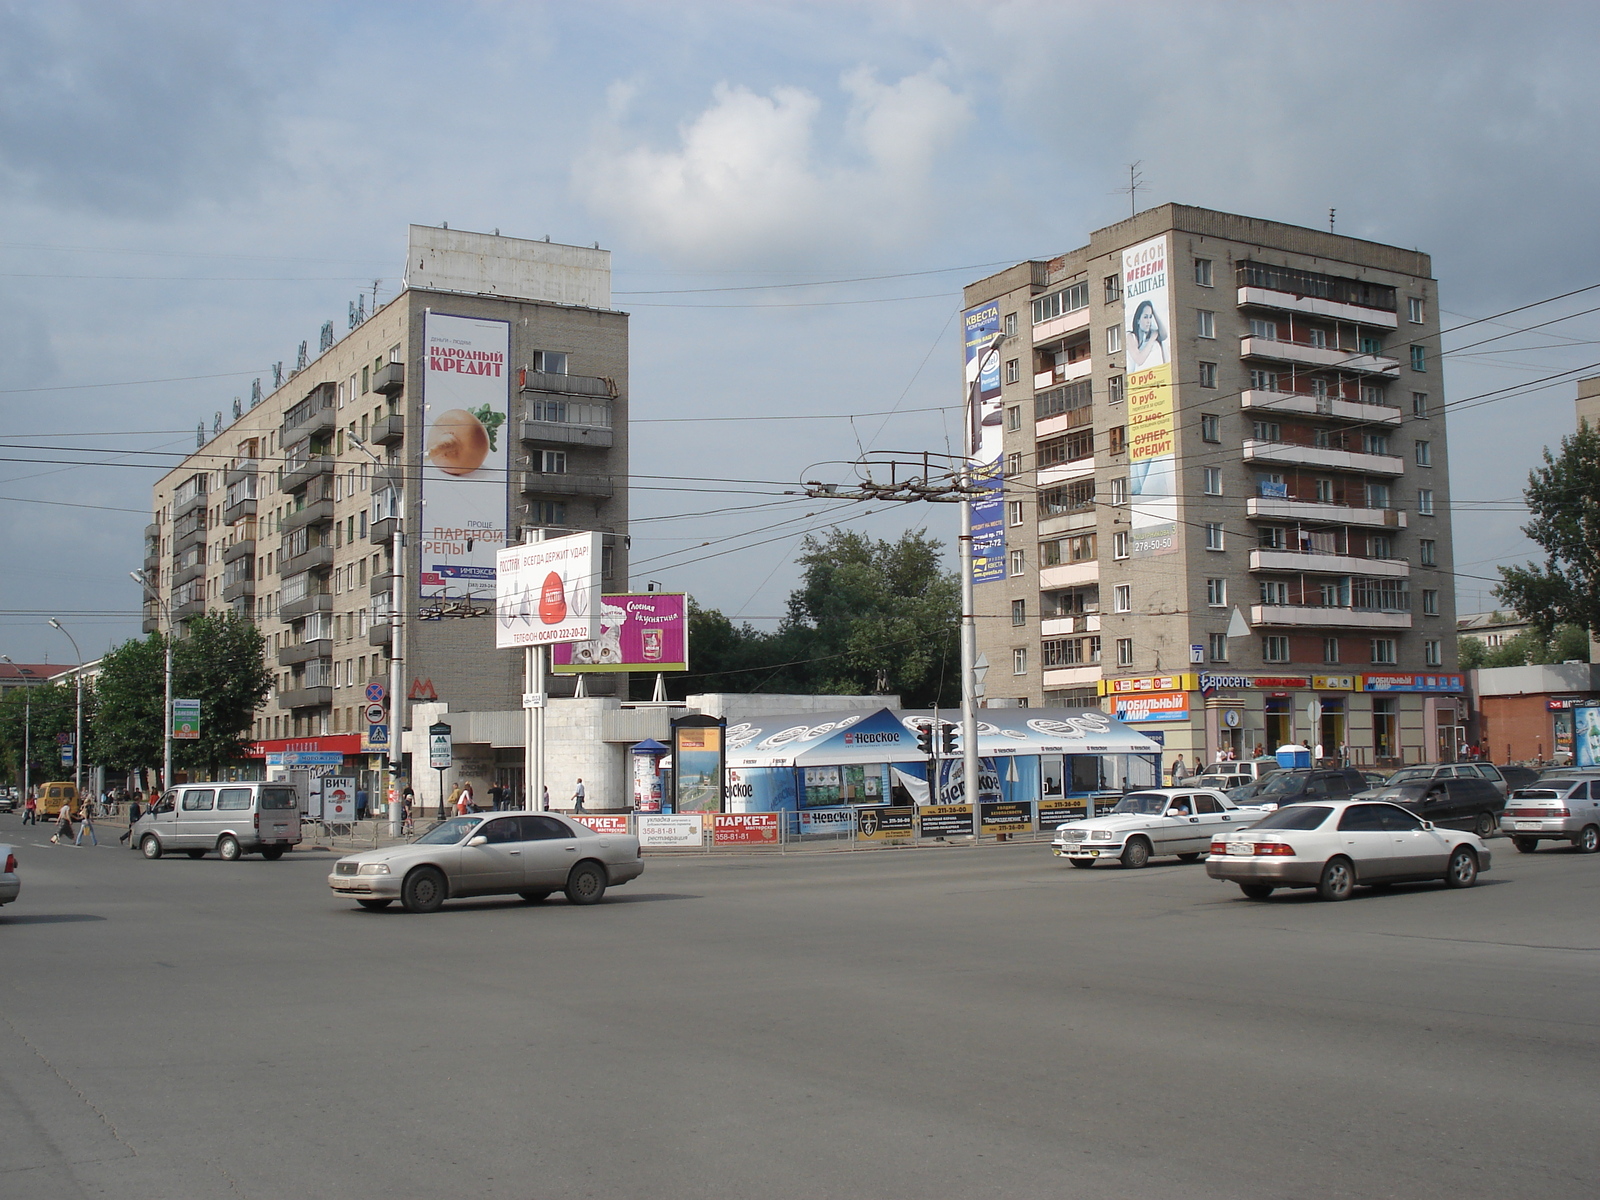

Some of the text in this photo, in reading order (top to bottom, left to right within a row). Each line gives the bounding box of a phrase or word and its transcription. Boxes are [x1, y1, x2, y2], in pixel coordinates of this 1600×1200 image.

[1126, 243, 1164, 268] САЛОН
[1127, 258, 1164, 282] МЕБЕЛИ
[1127, 273, 1165, 299] КАШТАН
[966, 306, 998, 326] КВЕСТА
[430, 346, 503, 362] НАРОДНЫЙ
[430, 356, 503, 377] КРЕДИТ
[1131, 376, 1136, 385] 0
[1139, 371, 1156, 385] руб.
[1131, 391, 1157, 405] 0 руб.
[1133, 415, 1143, 425] 12
[1133, 440, 1171, 458] КРЕДИТ
[467, 520, 493, 529] ПРОЩЕ
[1172, 525, 1176, 534] 3
[434, 527, 503, 543] ПАРЕНОЙ
[424, 541, 464, 555] РЕПЫ
[1135, 538, 1172, 552] 278-50-50
[523, 554, 544, 567] ВСЕГДА
[545, 549, 569, 564] ДЕРЖИТ
[570, 546, 589, 559] УДАР!
[626, 601, 655, 612] Слоеная
[514, 627, 587, 643] ТЕЛЕФОН ОСАГО 222-20-22
[1195, 651, 1200, 661] 7
[1200, 671, 1251, 692] Евросеть
[1126, 709, 1150, 720] МИР
[855, 732, 900, 744] Невское
[716, 832, 749, 840] 358-81-81
